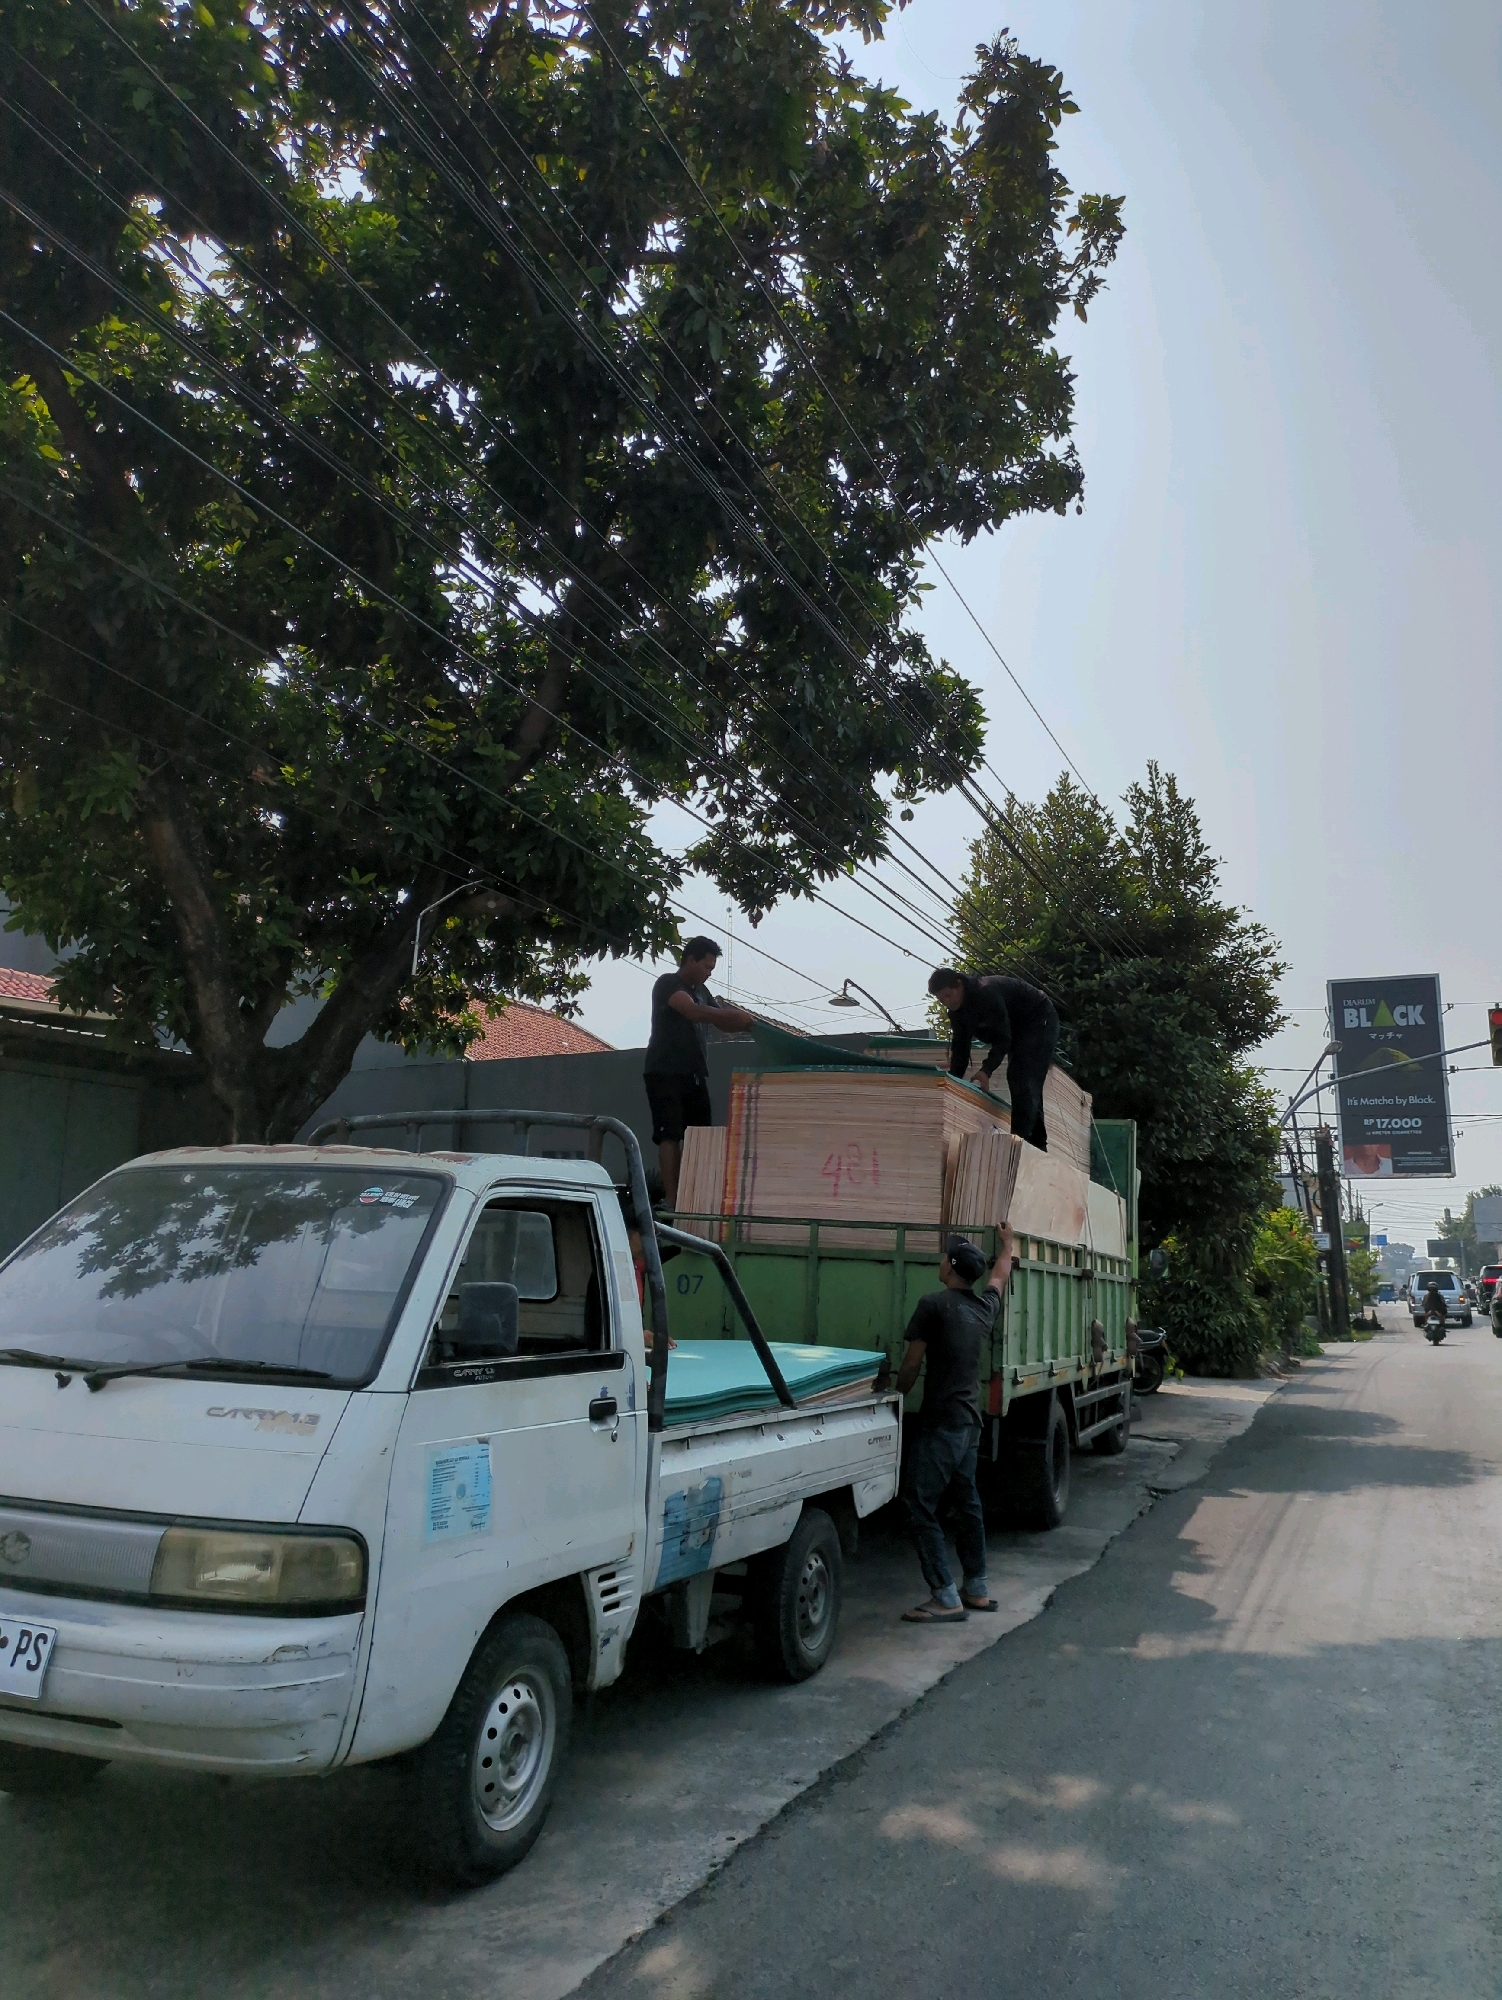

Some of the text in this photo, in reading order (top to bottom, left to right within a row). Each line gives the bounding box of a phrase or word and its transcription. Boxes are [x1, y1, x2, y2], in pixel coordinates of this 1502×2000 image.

[1342, 998, 1376, 1007] DJARUM
[1343, 1000, 1426, 1029] BLACK
[1347, 1094, 1436, 1107] It's Matcha by Black.
[1363, 1117, 1422, 1129] RP 17.000
[676, 1273, 704, 1296] 07
[9, 1628, 49, 1672] PS
